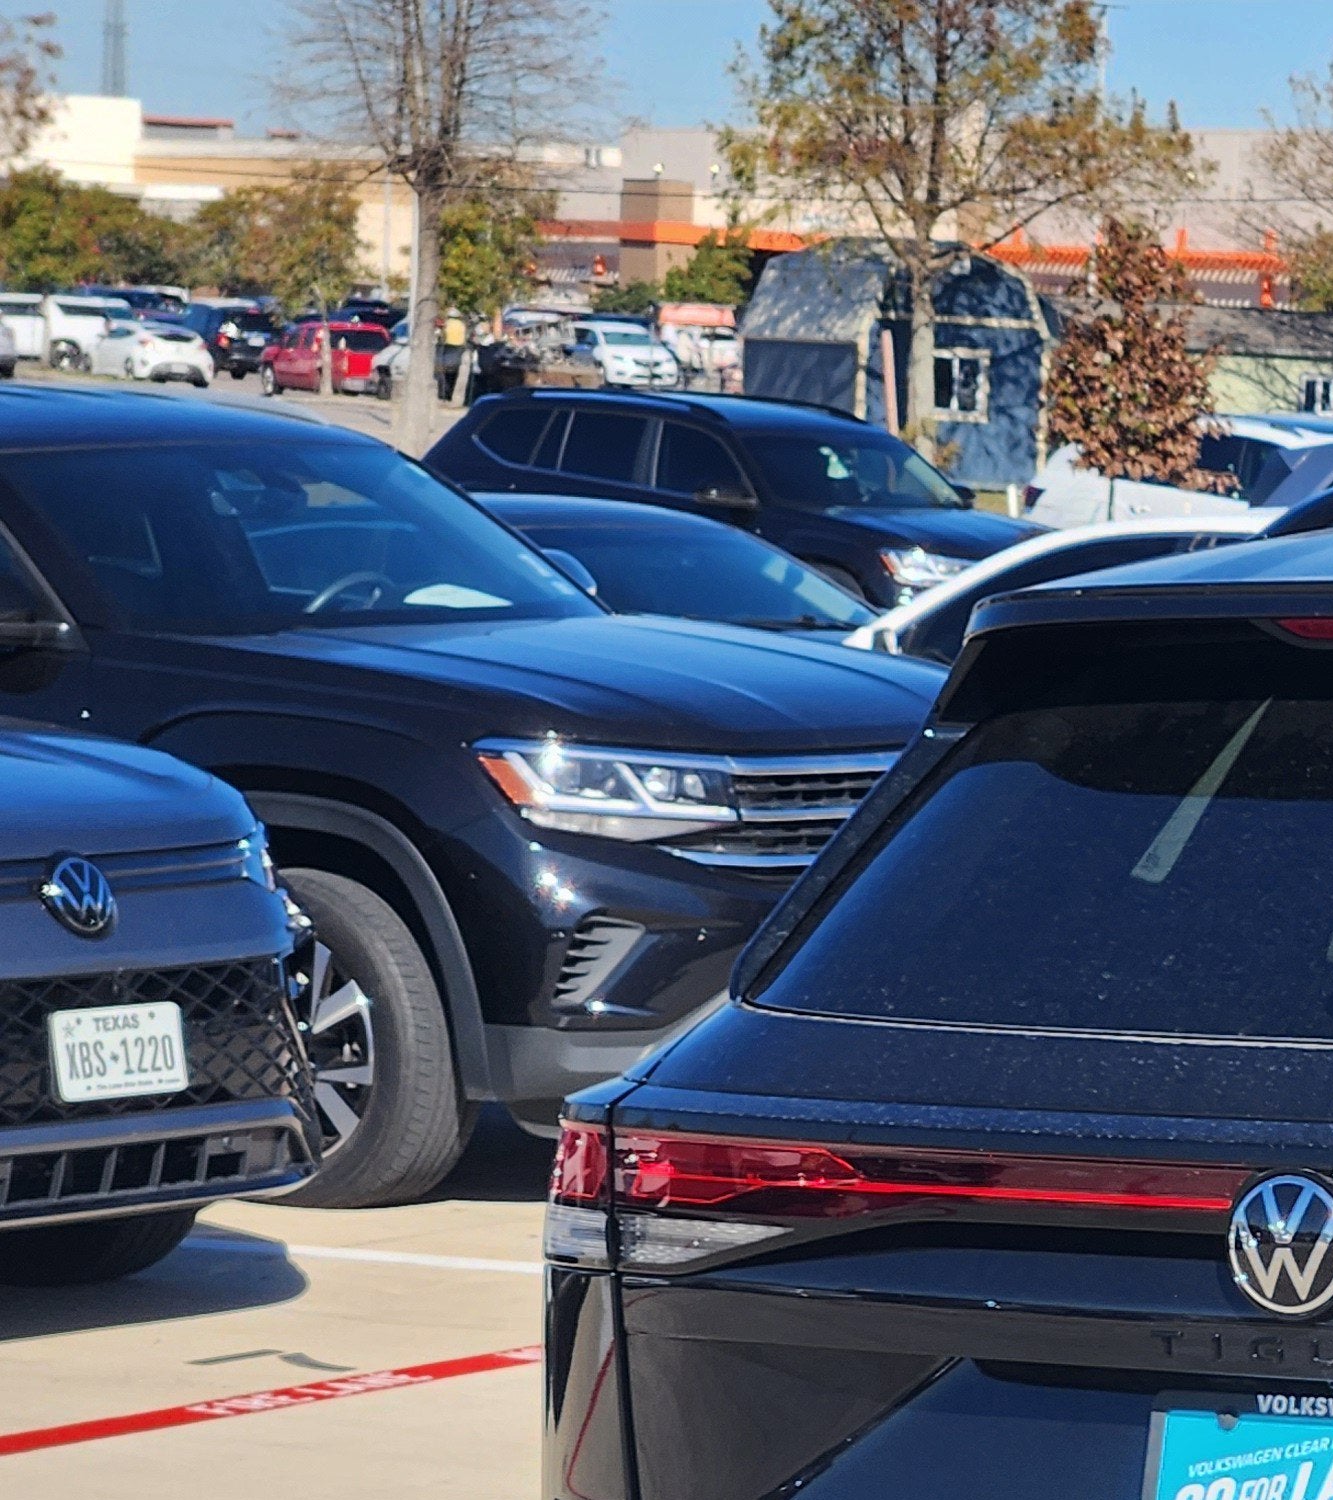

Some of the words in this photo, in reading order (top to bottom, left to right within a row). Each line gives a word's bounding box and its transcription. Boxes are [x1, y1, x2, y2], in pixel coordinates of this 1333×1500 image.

[93, 1013, 140, 1032] TEXAS
[1187, 1447, 1283, 1478] VOLKSWAGEN
[1284, 1437, 1331, 1458] CLEAR
